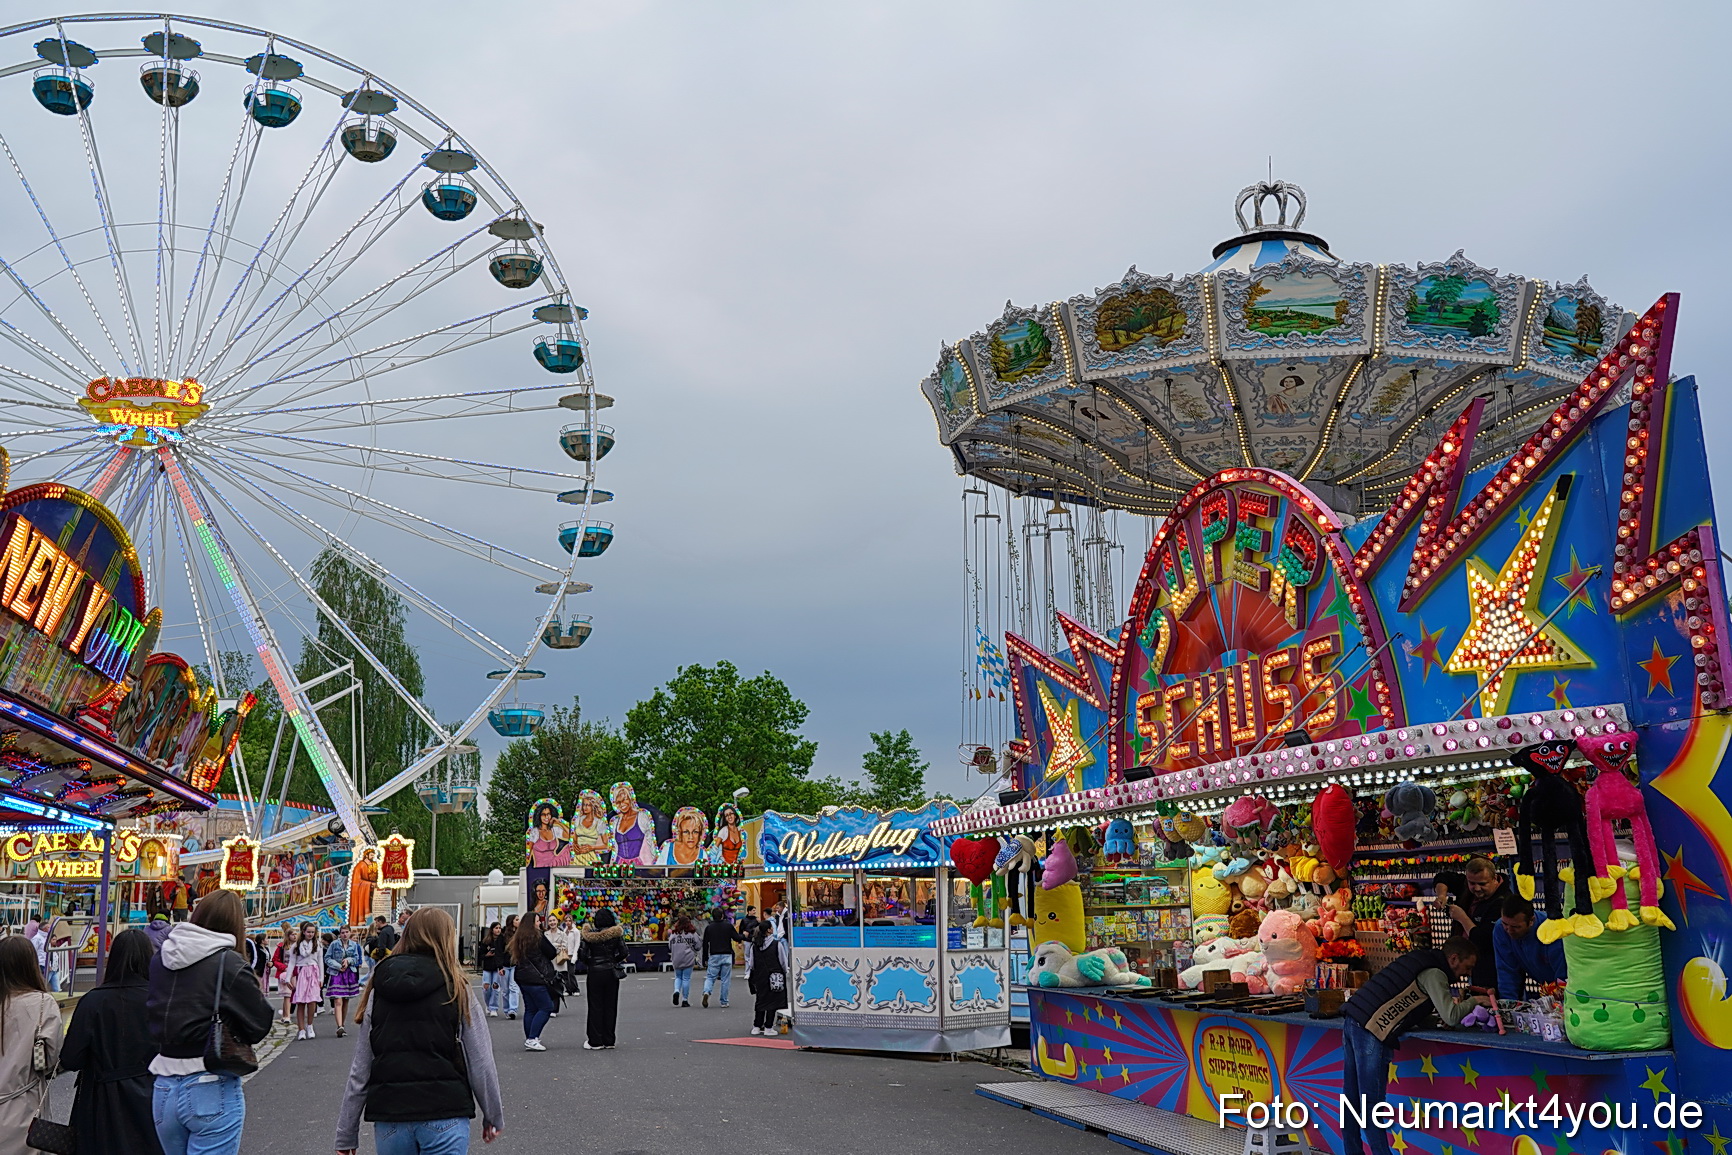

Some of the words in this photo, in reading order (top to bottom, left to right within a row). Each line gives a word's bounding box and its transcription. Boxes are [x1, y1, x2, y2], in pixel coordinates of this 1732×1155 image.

[86, 376, 204, 406] CAESAR'S
[108, 407, 179, 428] WHEEL
[0, 513, 85, 636] NEW
[68, 580, 146, 685] YORK
[1135, 487, 1321, 675] SUPER
[1136, 634, 1347, 766] SCHUSS
[779, 821, 921, 863] Wellenflug
[1375, 990, 1420, 1032] BURBERRY
[1532, 1019, 1538, 1030] 5
[1208, 1033, 1227, 1053] R+R
[1227, 1035, 1254, 1057] ROHR
[1546, 1024, 1552, 1035] 3
